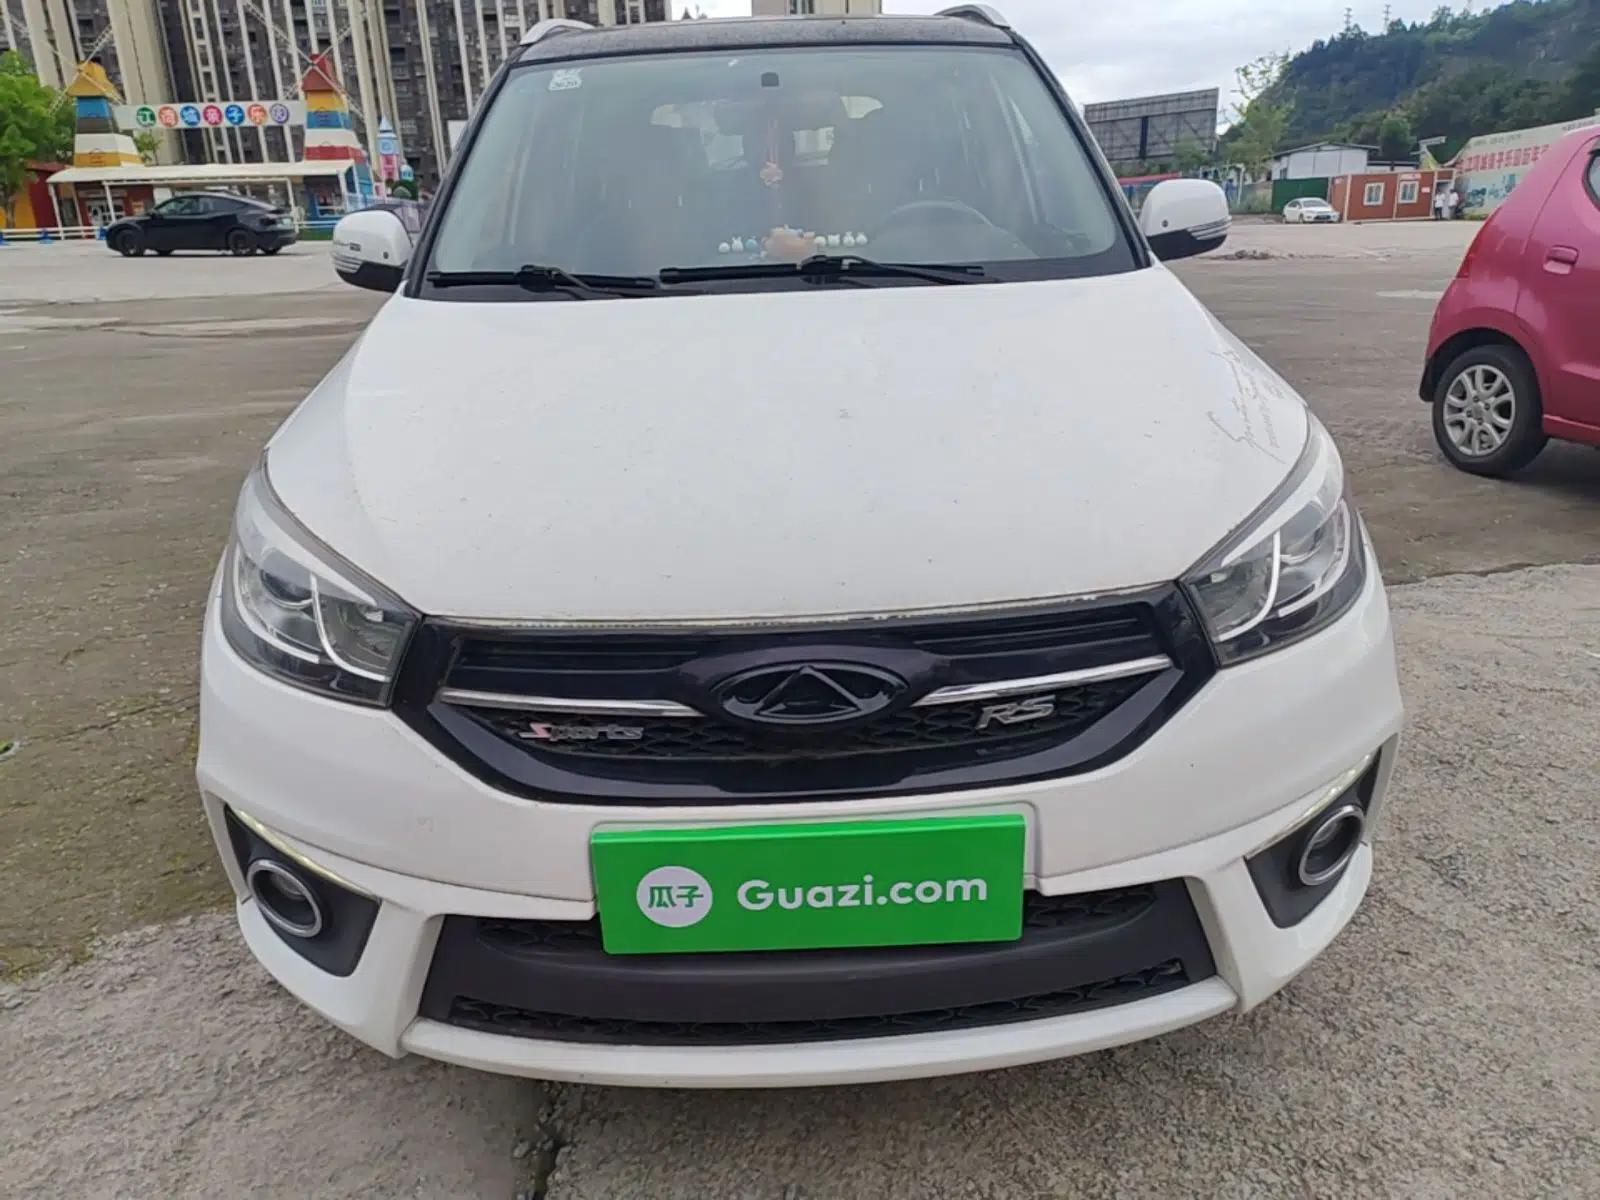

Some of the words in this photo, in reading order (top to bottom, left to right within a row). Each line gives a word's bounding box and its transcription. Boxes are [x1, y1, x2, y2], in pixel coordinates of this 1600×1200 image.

[975, 694, 1056, 729] RS
[518, 722, 644, 741] Sports
[647, 885, 704, 909] 瓜子
[736, 874, 988, 911] Guazi.com
